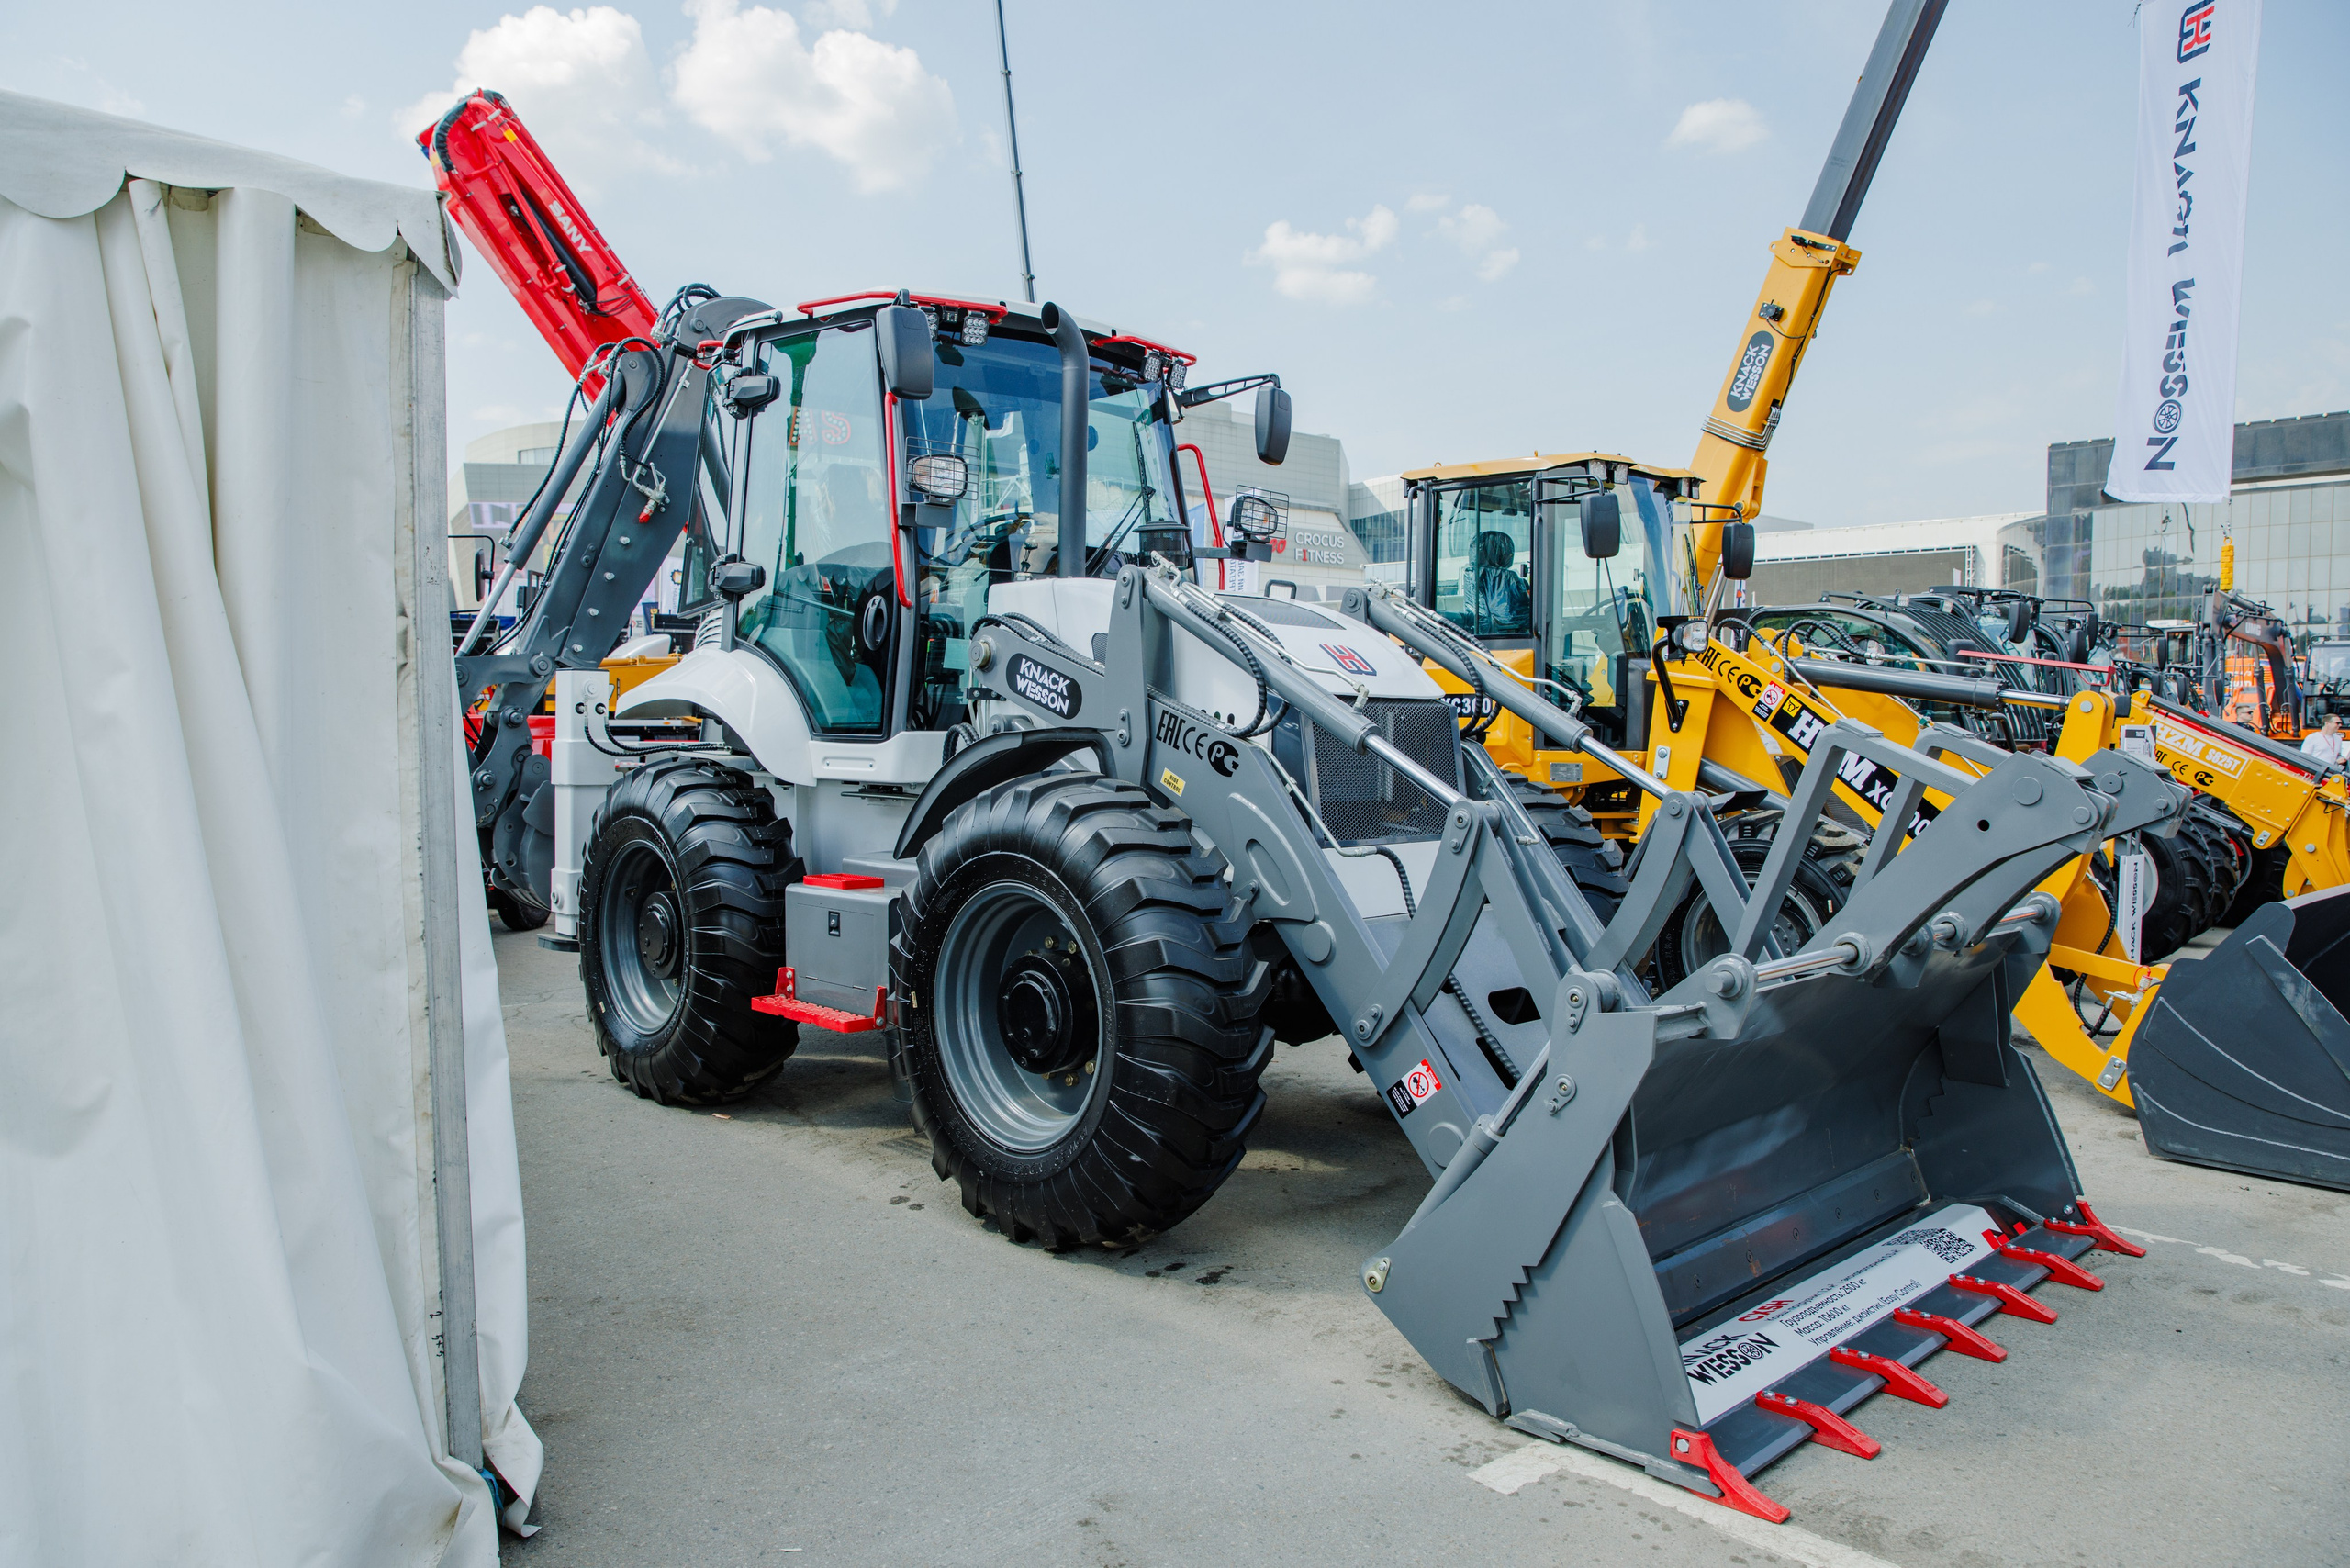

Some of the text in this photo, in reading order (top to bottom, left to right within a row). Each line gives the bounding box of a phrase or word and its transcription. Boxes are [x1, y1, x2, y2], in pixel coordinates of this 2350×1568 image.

[549, 200, 593, 252] SANY
[1730, 343, 1759, 398] KNACK
[1740, 343, 1771, 401] WESSON
[1294, 548, 1345, 565] FITNESS
[1295, 532, 1345, 548] CROCUS
[2245, 622, 2261, 636] UMG
[1016, 674, 1069, 715] WESSON
[1019, 657, 1070, 696] KNACK
[2156, 722, 2206, 757] HZM
[2205, 748, 2241, 772] S825T
[1163, 778, 1181, 794] CONTROL
[1842, 1281, 1863, 1294] 2500
[1859, 1278, 1867, 1286] кг
[1794, 1318, 1825, 1338] Масса:
[1818, 1307, 1841, 1324] 10600
[1841, 1303, 1852, 1313] кг
[1808, 1317, 1856, 1347] Управление:
[1894, 1279, 1922, 1296] Control)
[1687, 1332, 1780, 1386] WESSON
